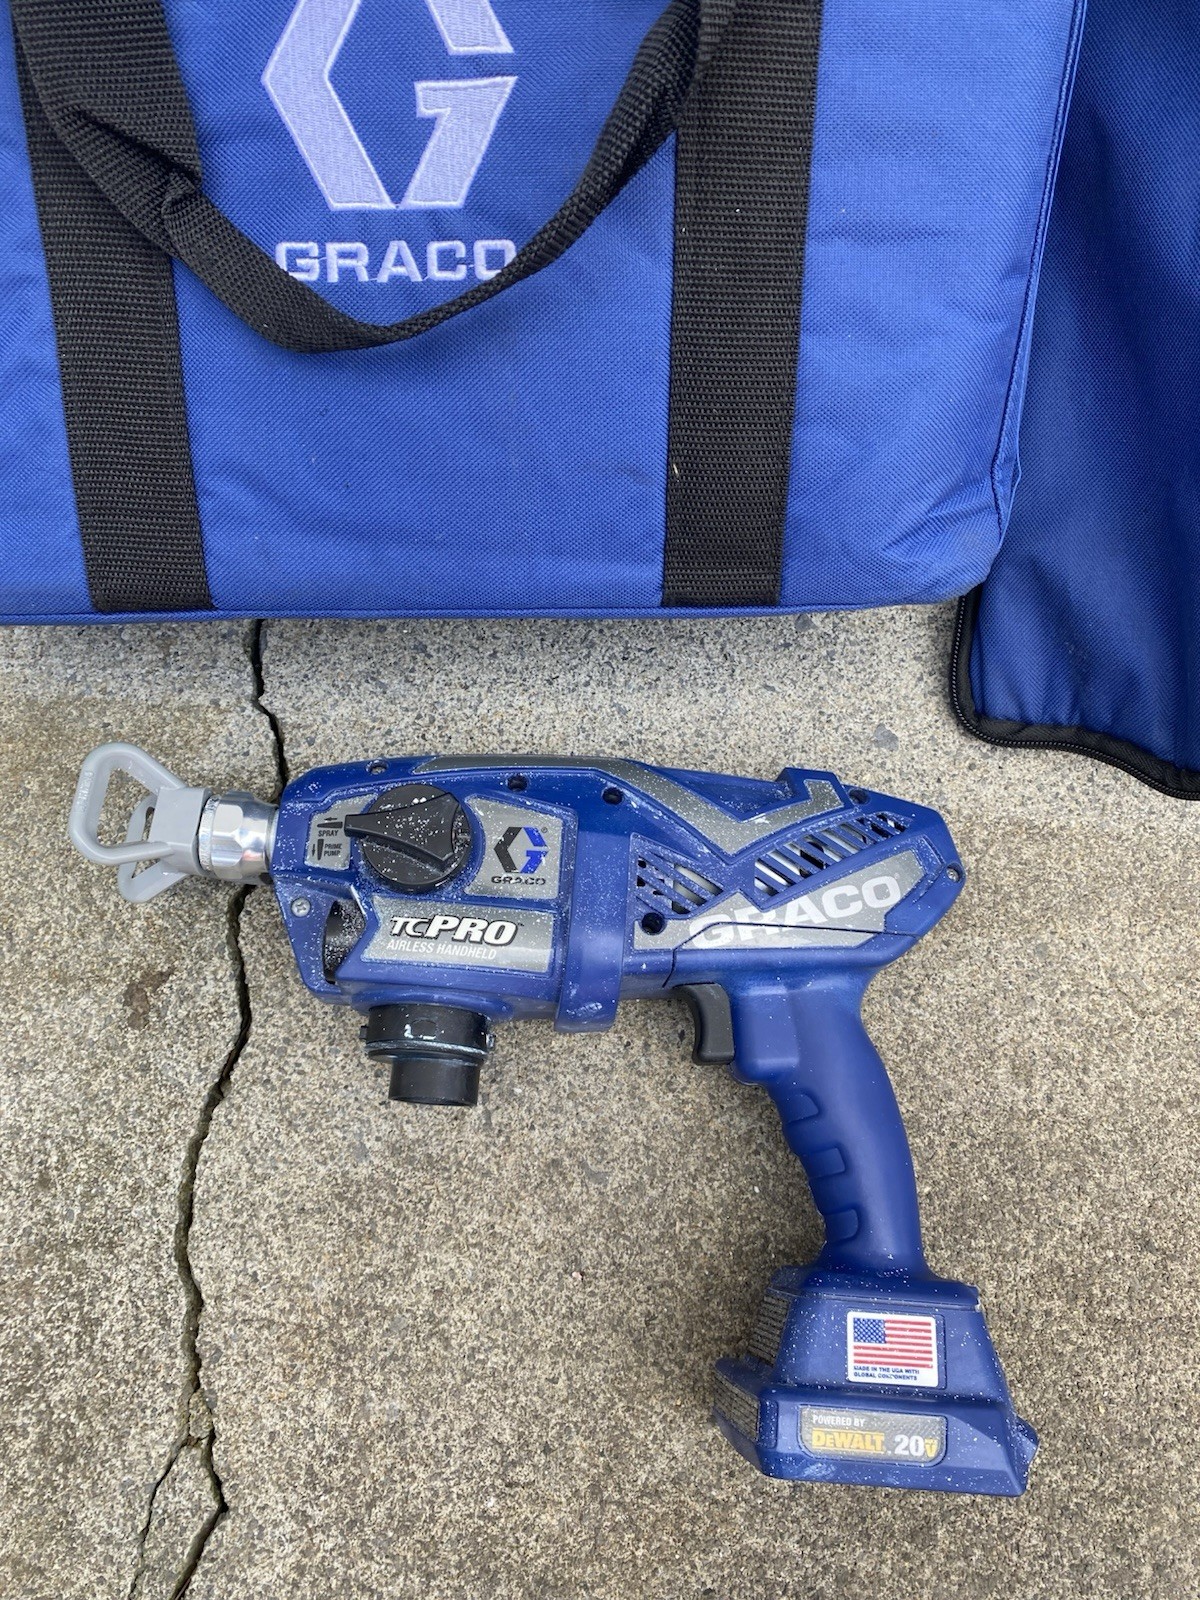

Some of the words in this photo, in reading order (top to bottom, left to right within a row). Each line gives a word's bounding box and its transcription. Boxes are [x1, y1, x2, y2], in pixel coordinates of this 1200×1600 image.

[275, 239, 517, 282] GRACO
[318, 829, 339, 837] SPRAY
[491, 876, 546, 885] GRACO
[689, 876, 901, 948] GRACO
[387, 939, 434, 954] AIRLESS
[436, 943, 497, 960] HANDHELD
[812, 1414, 852, 1426] POWERED
[853, 1417, 865, 1427] BY
